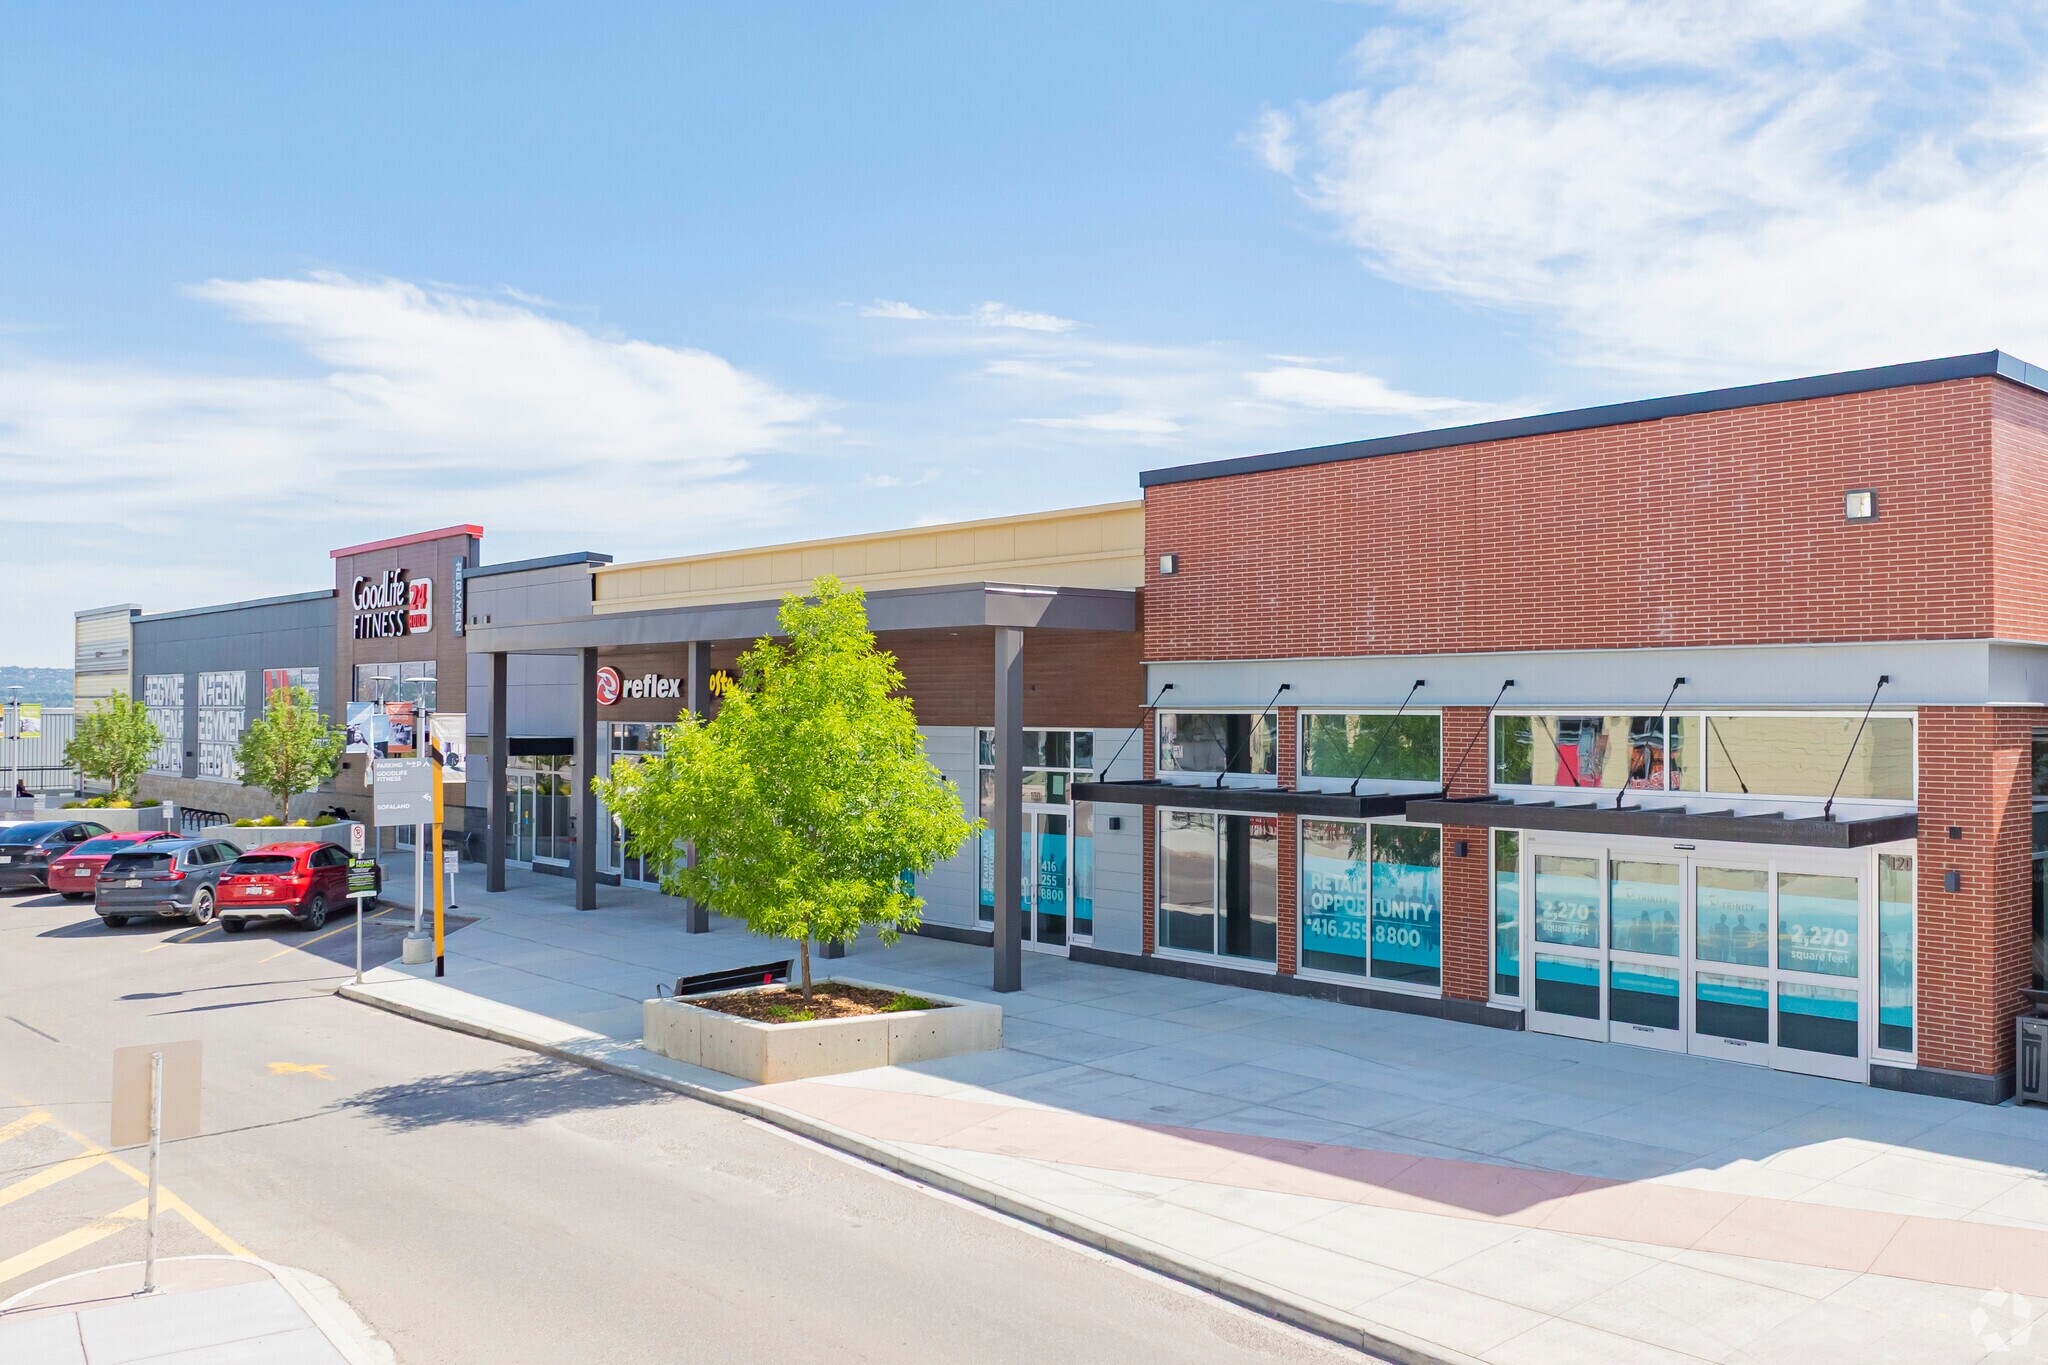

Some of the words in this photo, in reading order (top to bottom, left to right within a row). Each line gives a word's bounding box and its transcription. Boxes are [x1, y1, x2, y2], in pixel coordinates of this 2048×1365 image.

[353, 568, 404, 610] GoodLife
[409, 583, 428, 610] 24
[354, 609, 404, 639] FITNESS
[409, 613, 428, 628] HOUR
[622, 673, 681, 698] reflex
[377, 803, 411, 811] SOFALAND
[1041, 860, 1057, 873] 416
[1889, 856, 1913, 872] 120
[1041, 874, 1057, 887] 255
[1311, 872, 1367, 895] RETAIL
[1041, 888, 1064, 902] 8800
[1638, 895, 1668, 905] TRINITY
[1311, 892, 1433, 922] OPPORTUNITY
[1542, 901, 1589, 921] 2,270
[1722, 902, 1755, 912] TRINITY
[1542, 923, 1571, 938] square
[1572, 925, 1589, 936] feet
[1790, 924, 1849, 948] 2,270
[1791, 950, 1826, 963] square
[1828, 952, 1849, 964] feet
